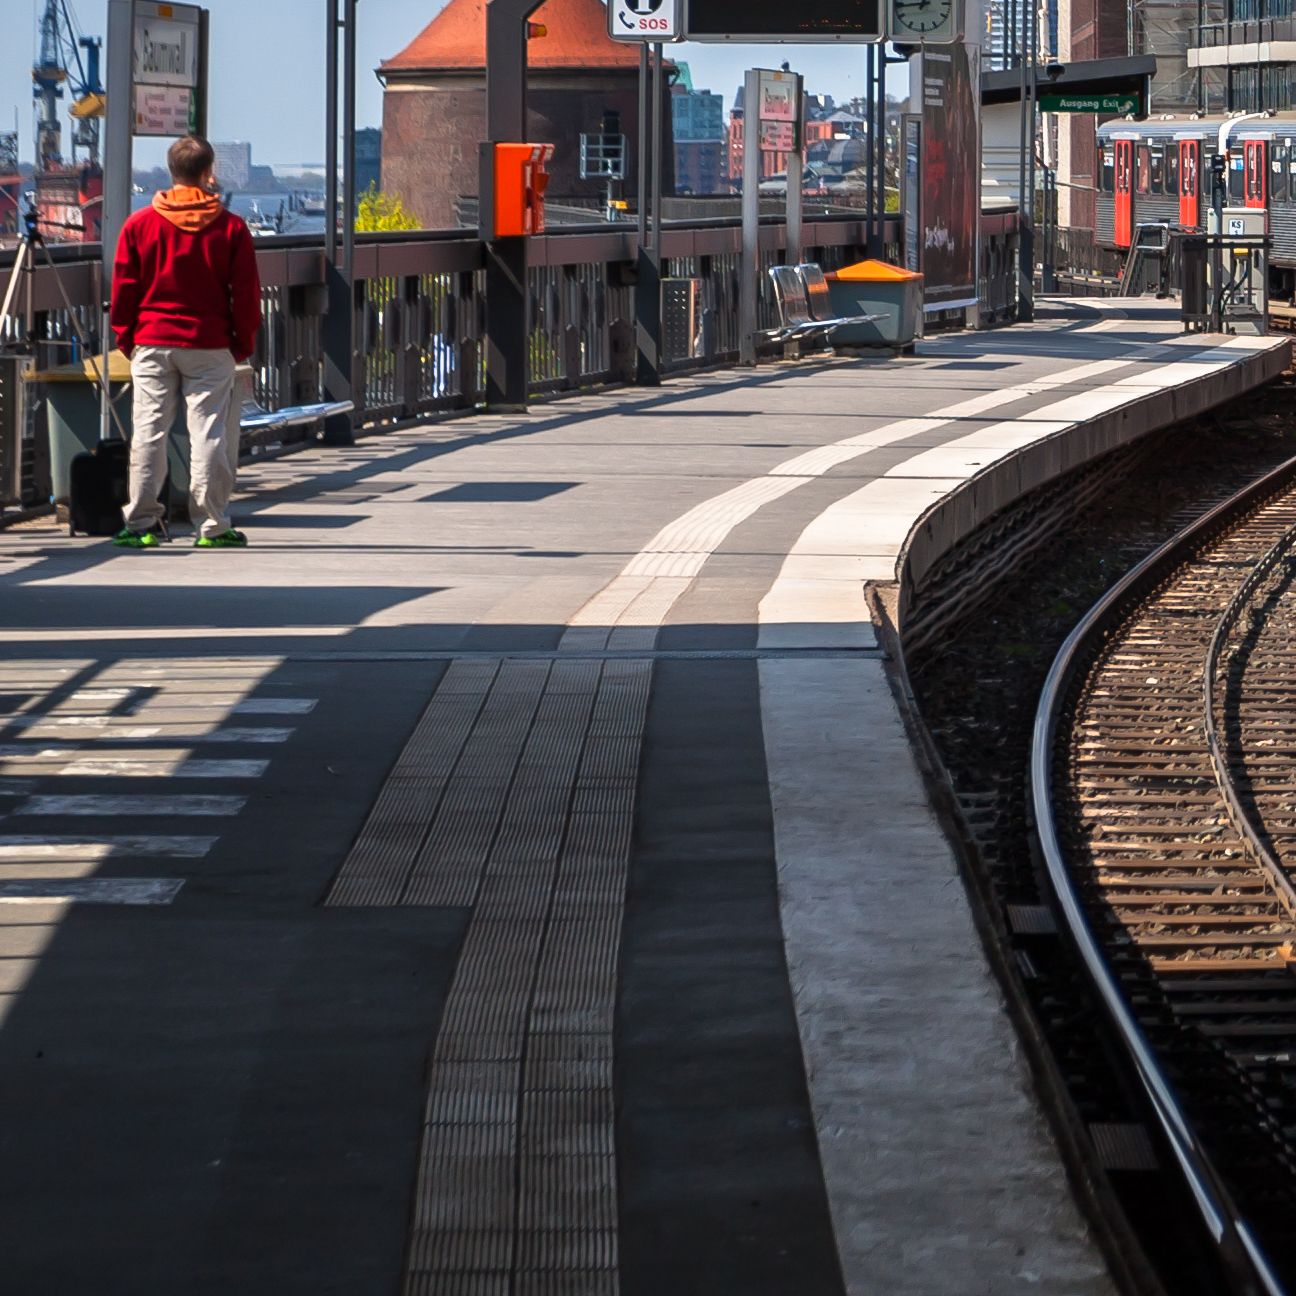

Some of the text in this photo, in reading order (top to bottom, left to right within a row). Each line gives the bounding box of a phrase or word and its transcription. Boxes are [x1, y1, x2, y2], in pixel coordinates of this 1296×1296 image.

[639, 18, 668, 30] SOS
[1060, 99, 1118, 109] Ausgang Exit
